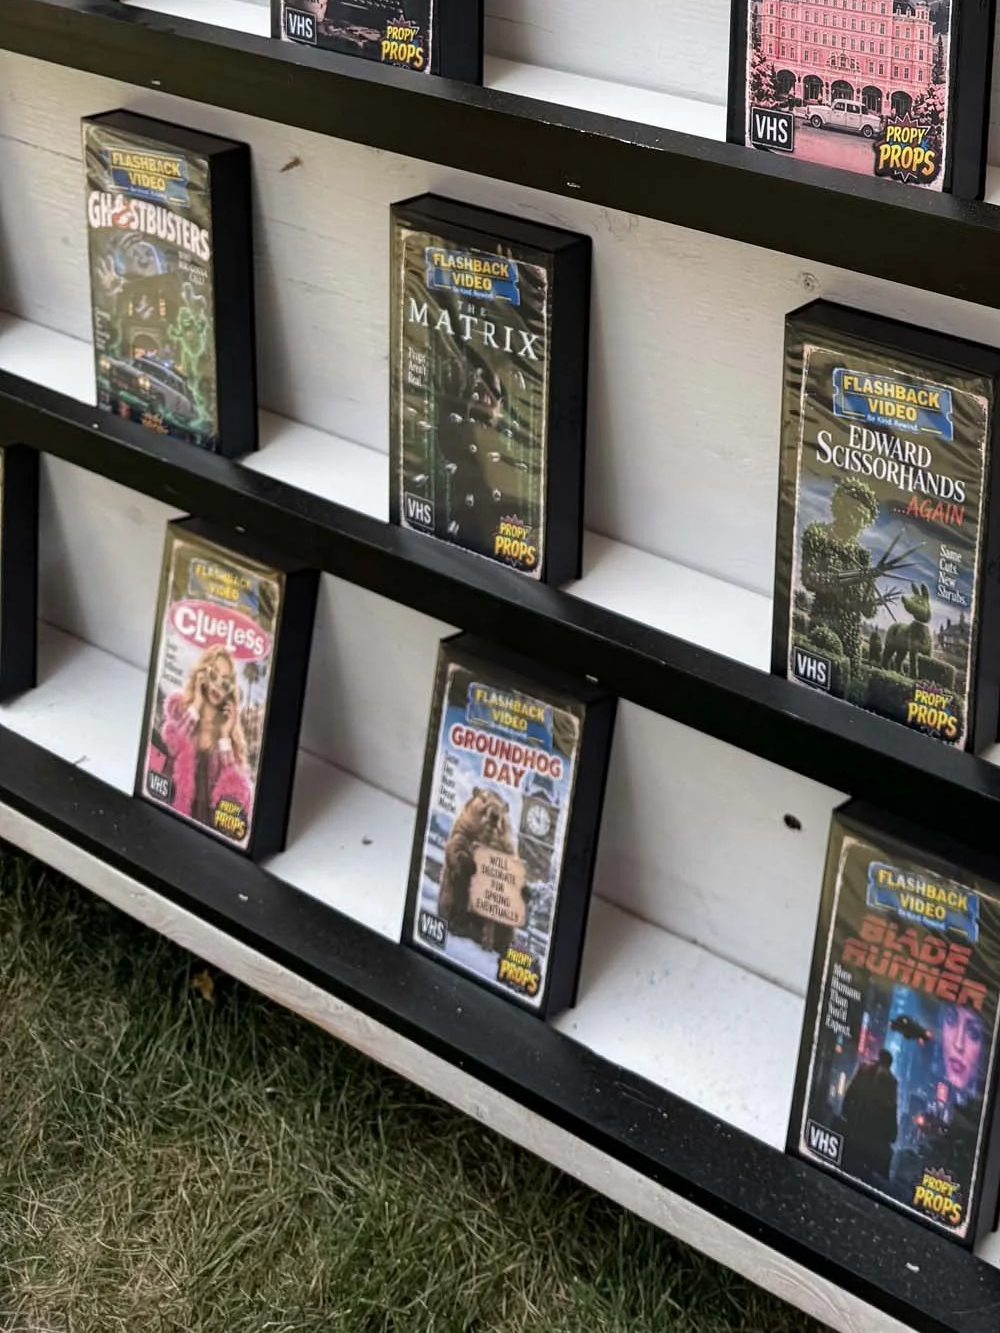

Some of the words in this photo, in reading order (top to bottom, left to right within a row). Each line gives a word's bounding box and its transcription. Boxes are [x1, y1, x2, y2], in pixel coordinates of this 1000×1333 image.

[288, 13, 313, 38] VHS
[387, 26, 416, 40] PROPY
[381, 40, 423, 68] PROPS
[755, 114, 788, 143] VHS
[886, 126, 925, 144] PROPY
[112, 153, 181, 176] FLASHBACK
[879, 144, 935, 176] PROPS
[128, 172, 165, 191] VIDEO
[433, 253, 509, 277] FLASHBACK
[452, 272, 492, 291] VIDEO
[408, 298, 540, 360] MATRIX
[843, 376, 940, 408] FLASHBACK
[868, 398, 917, 421] VIDEO
[849, 425, 932, 468] EDWARD
[816, 430, 965, 503] SCISSORHANDS
[408, 498, 432, 523] VHS
[500, 522, 528, 539] PROPY
[494, 536, 536, 565] PROPS
[940, 544, 962, 562] Same
[796, 653, 827, 683] VHS
[475, 689, 544, 722] FLASHBACK
[915, 689, 948, 709] PROPY
[492, 709, 528, 731] VIDEO
[907, 702, 957, 737] PROPS
[451, 725, 562, 778] GROUNDHOG
[150, 774, 168, 797] VHS
[483, 758, 526, 788] DAY
[215, 810, 246, 838] PROPS
[878, 869, 968, 911] FLASHBACK
[900, 893, 946, 919] VIDEO
[421, 915, 444, 941] VHS
[499, 960, 539, 994] PROPS
[810, 1127, 838, 1157] VHS
[922, 1174, 956, 1196] PROPY
[913, 1186, 962, 1224] PROPS
